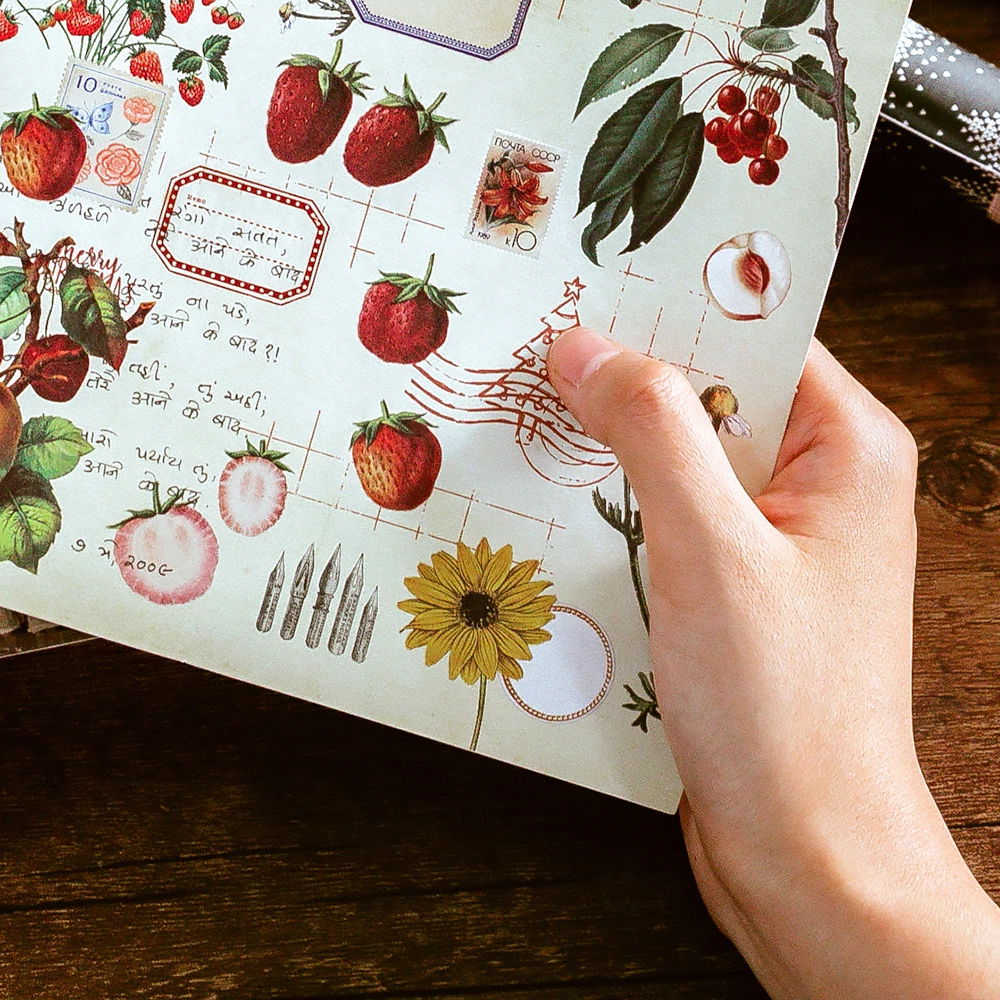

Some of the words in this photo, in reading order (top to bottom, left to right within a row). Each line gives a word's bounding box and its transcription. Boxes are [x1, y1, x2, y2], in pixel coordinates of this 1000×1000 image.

[75, 73, 98, 95] 10
[494, 137, 526, 154] ПОЧТА
[532, 148, 560, 162] СССР
